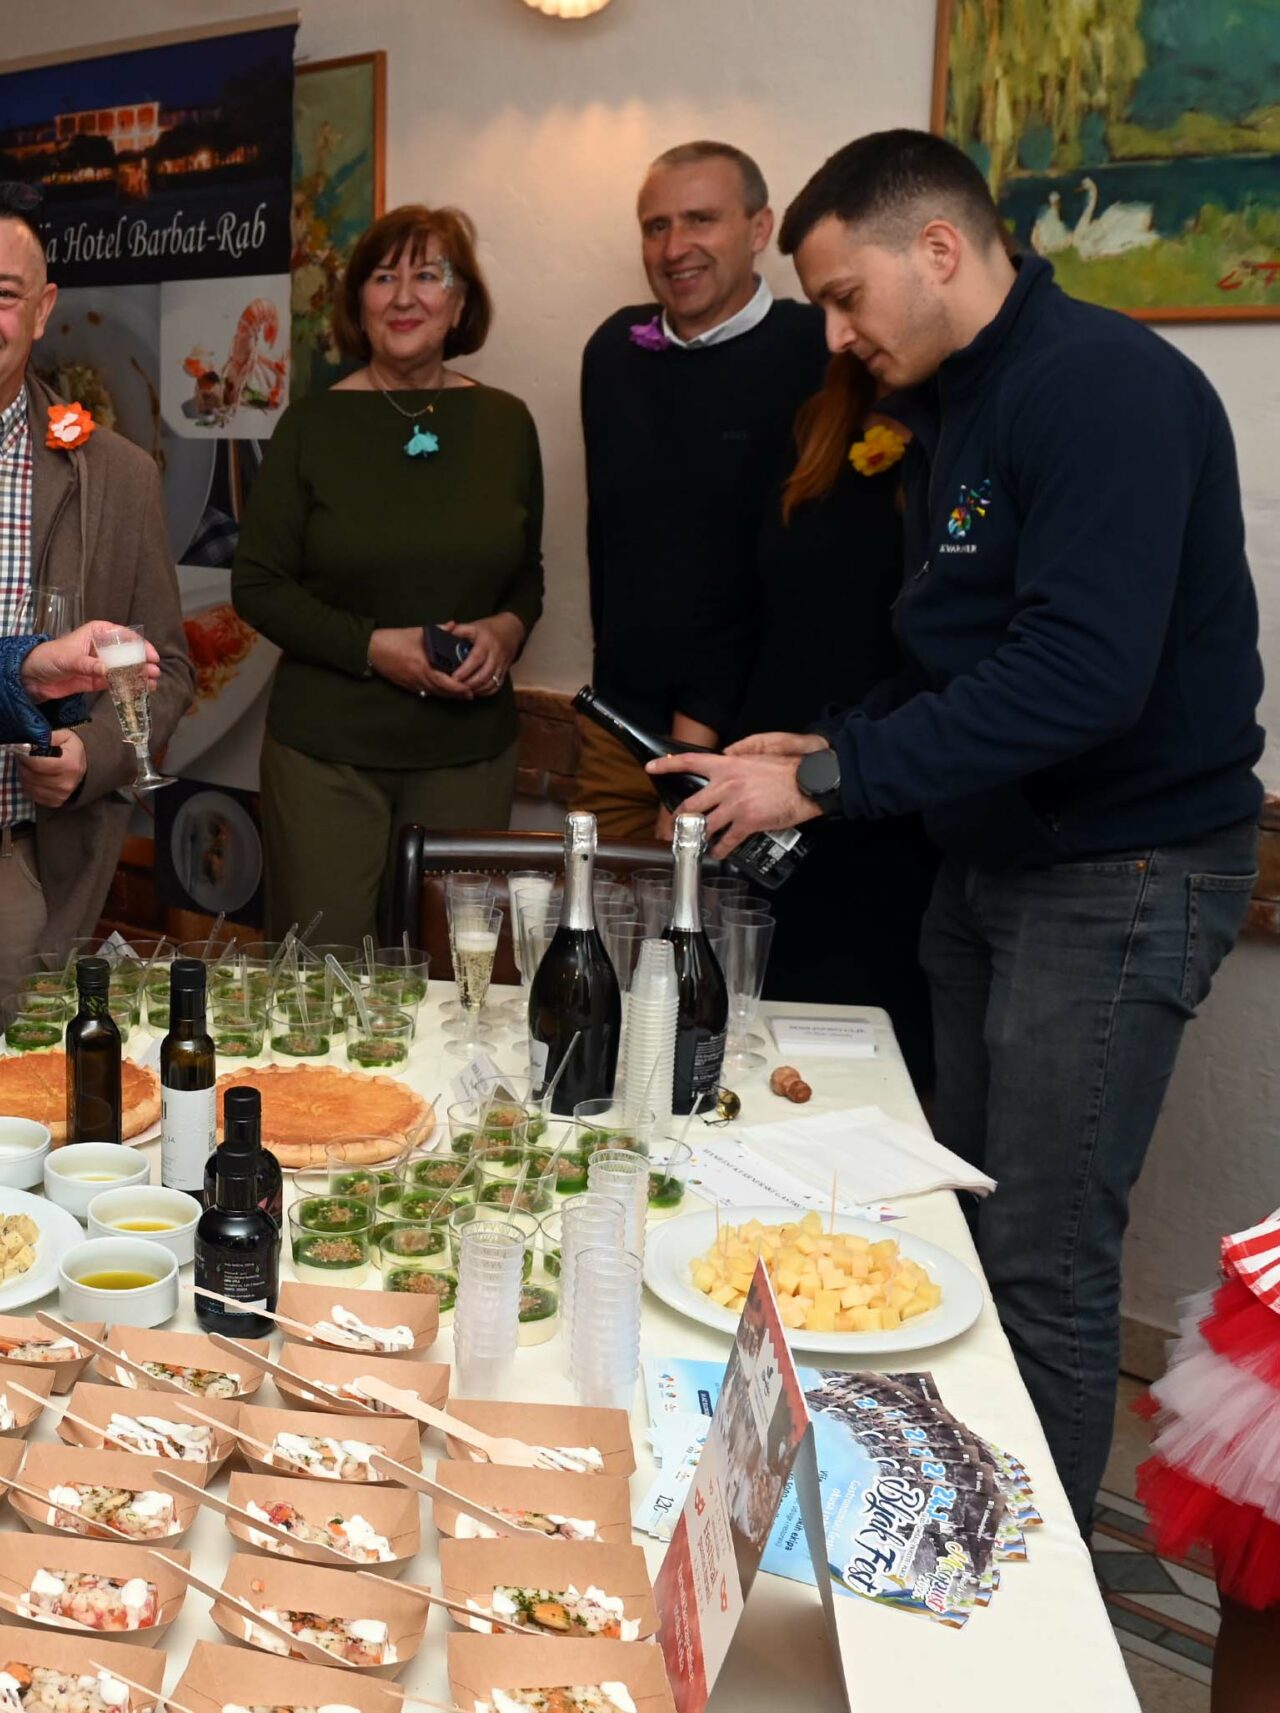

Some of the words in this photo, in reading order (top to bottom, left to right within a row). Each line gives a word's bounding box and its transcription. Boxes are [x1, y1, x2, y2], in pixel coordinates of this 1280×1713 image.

[62, 216, 127, 264] Hotel
[127, 202, 267, 259] Barbat-Rab
[860, 1478, 920, 1547] Bljak
[847, 1537, 897, 1593] Fest
